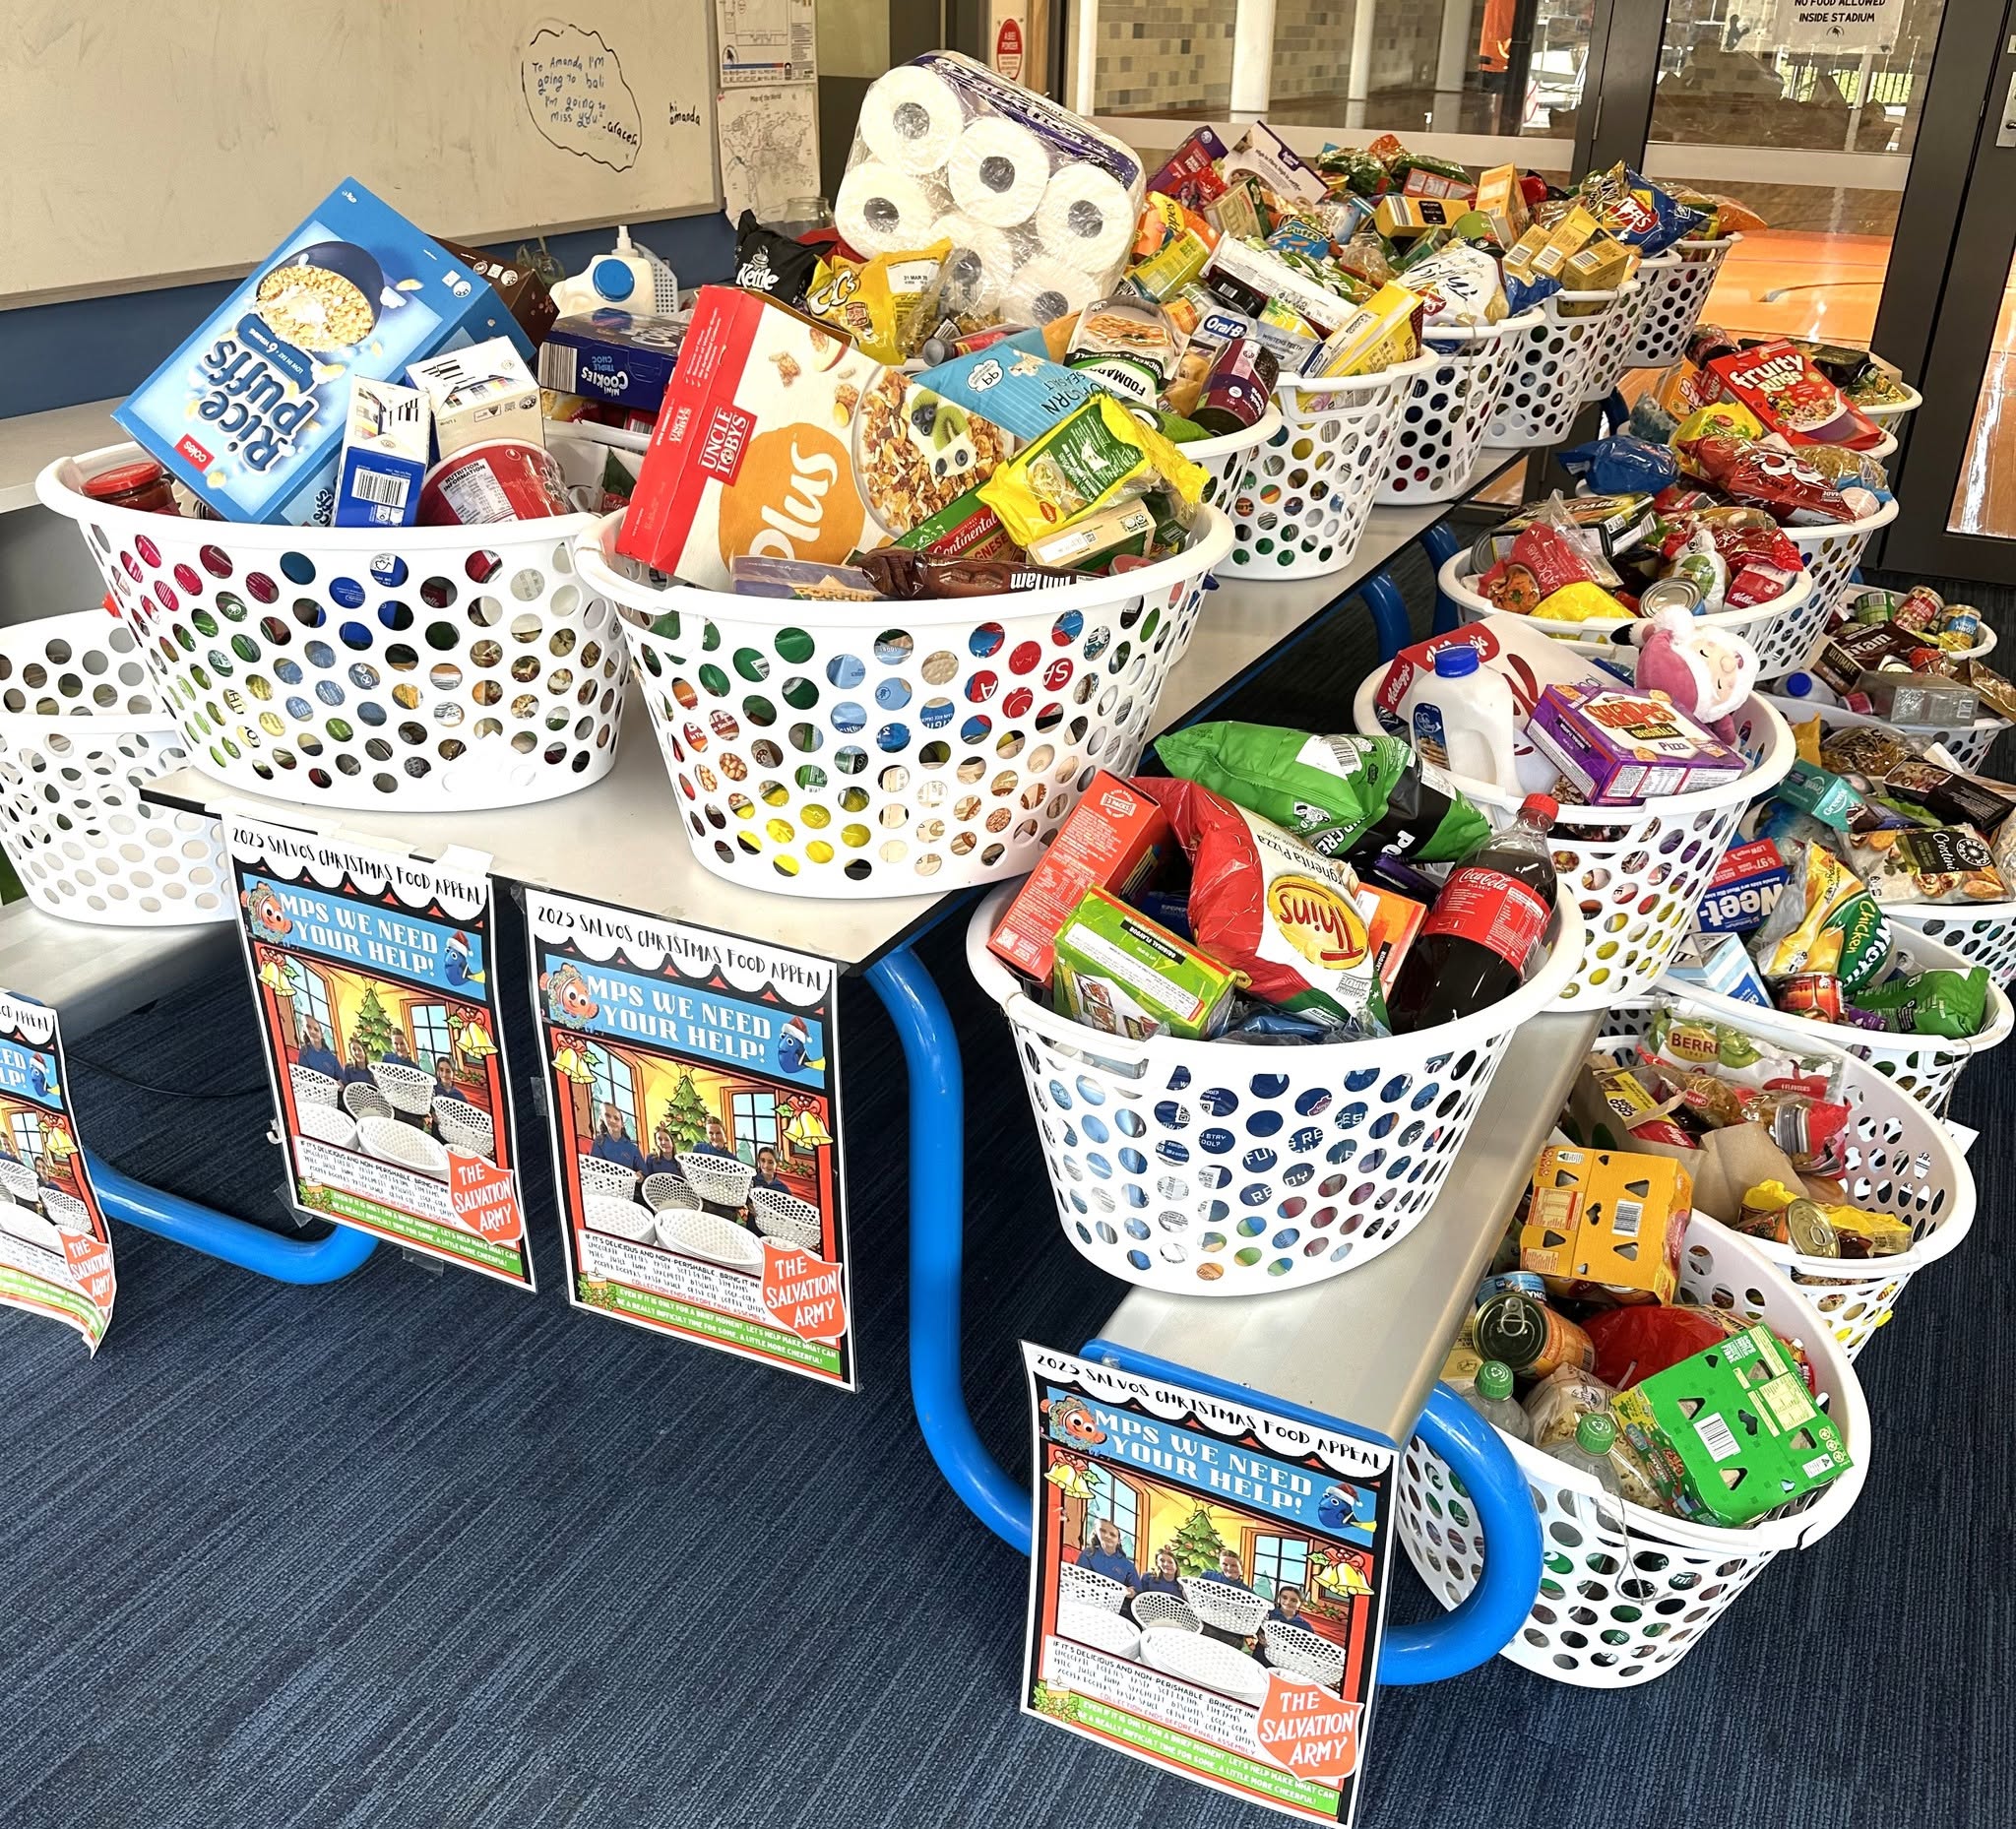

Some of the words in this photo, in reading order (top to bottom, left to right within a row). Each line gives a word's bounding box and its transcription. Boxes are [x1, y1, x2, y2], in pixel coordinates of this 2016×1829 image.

[1798, 13, 1829, 23] INSIDE
[1831, 12, 1875, 23] STADIUM
[532, 62, 543, 73] To
[550, 55, 583, 72] Amanda
[537, 74, 563, 95] going
[566, 74, 577, 84] to
[585, 72, 604, 89] bali
[550, 111, 572, 123] miss
[565, 96, 595, 115] going
[598, 101, 605, 110] to
[669, 100, 677, 114] hi
[669, 105, 701, 126] amanda
[734, 262, 781, 291] Kettle
[1205, 317, 1245, 338] Oral-B
[1729, 353, 1806, 391] fruity
[1755, 369, 1803, 394] Rings
[204, 340, 315, 436] puffs
[197, 390, 288, 472] Rice
[700, 406, 733, 470] UNCLE
[715, 413, 748, 475] TOBYS
[183, 440, 207, 463] coles
[443, 464, 486, 491] INFORMATION
[444, 462, 480, 484] NUTRITION
[933, 512, 998, 554] Continental
[1827, 647, 1858, 676] ULTIMATE
[1387, 663, 1412, 705] Kellogg's
[1659, 741, 1691, 752] Pizza
[1256, 834, 1292, 861] Pizza
[1932, 832, 1954, 872] Crostini
[232, 827, 265, 849] 2025
[267, 835, 316, 861] SALVOS
[318, 849, 394, 882] CHRISTMAS
[396, 864, 431, 890] FOOD
[435, 878, 484, 907] APPEAL
[1458, 868, 1513, 891] Coca-Cola
[1468, 883, 1491, 892] CLASSIC
[280, 891, 329, 923] MPS
[334, 907, 372, 935] WE
[377, 917, 438, 955] NEED
[1128, 926, 1153, 946] FLAVOUR
[1277, 887, 1364, 962] Thins
[1846, 899, 1875, 955] Chicken
[294, 919, 362, 958] YOUR
[366, 938, 435, 978] HELP!
[536, 906, 575, 928] 2025
[579, 914, 633, 943] SALVOS
[637, 929, 723, 965] CHRISTMAS
[726, 948, 767, 974] FOOD
[770, 963, 825, 991] APPEAL
[1152, 940, 1176, 959] ORIGINAL
[587, 975, 645, 1008] MPS
[650, 988, 695, 1020] WE
[700, 1003, 772, 1041] NEED
[602, 1003, 680, 1042] YOUR
[686, 1025, 767, 1064] HELP!
[1199, 1138, 1221, 1147] OOL?
[458, 1163, 485, 1186] THE
[453, 1174, 511, 1214] SALVATION
[478, 1203, 514, 1232] ARMY
[68, 1238, 91, 1260] THE
[70, 1252, 110, 1283] SALVATION
[775, 1256, 807, 1281] THE
[91, 1276, 112, 1302] ARMY
[766, 1270, 838, 1309] SALVATION
[792, 1297, 836, 1329] ARMY
[1036, 1354, 1081, 1377] 2025
[1085, 1367, 1151, 1398] SALVOS
[1155, 1389, 1258, 1431] CHRISTMAS
[1263, 1419, 1311, 1445] FOOD
[1317, 1437, 1384, 1472] APPEAL
[1095, 1409, 1161, 1445] MPS
[1169, 1432, 1220, 1467] WE
[1228, 1453, 1313, 1497] NEED
[1112, 1433, 1200, 1481] YOUR
[1209, 1467, 1303, 1515] HELP!
[1076, 1649, 1114, 1668] DELICIOUS
[1115, 1664, 1133, 1674] AND
[1208, 1697, 1233, 1712] BRING
[1280, 1690, 1321, 1713] THE
[1165, 1717, 1192, 1733] BEFORE
[1217, 1737, 1256, 1755] ASSEMBLY
[1259, 1709, 1354, 1743] SALVATION
[1288, 1735, 1349, 1767] ARMY
[1176, 1749, 1193, 1760] FOR
[1250, 1776, 1274, 1791] MORE
[1274, 1786, 1316, 1805] CHEERFUL!
[1250, 1763, 1270, 1776] HELP
[1270, 1771, 1294, 1787] MAKE
[1294, 1781, 1317, 1794] WHAT
[1317, 1789, 1335, 1799] CAN
